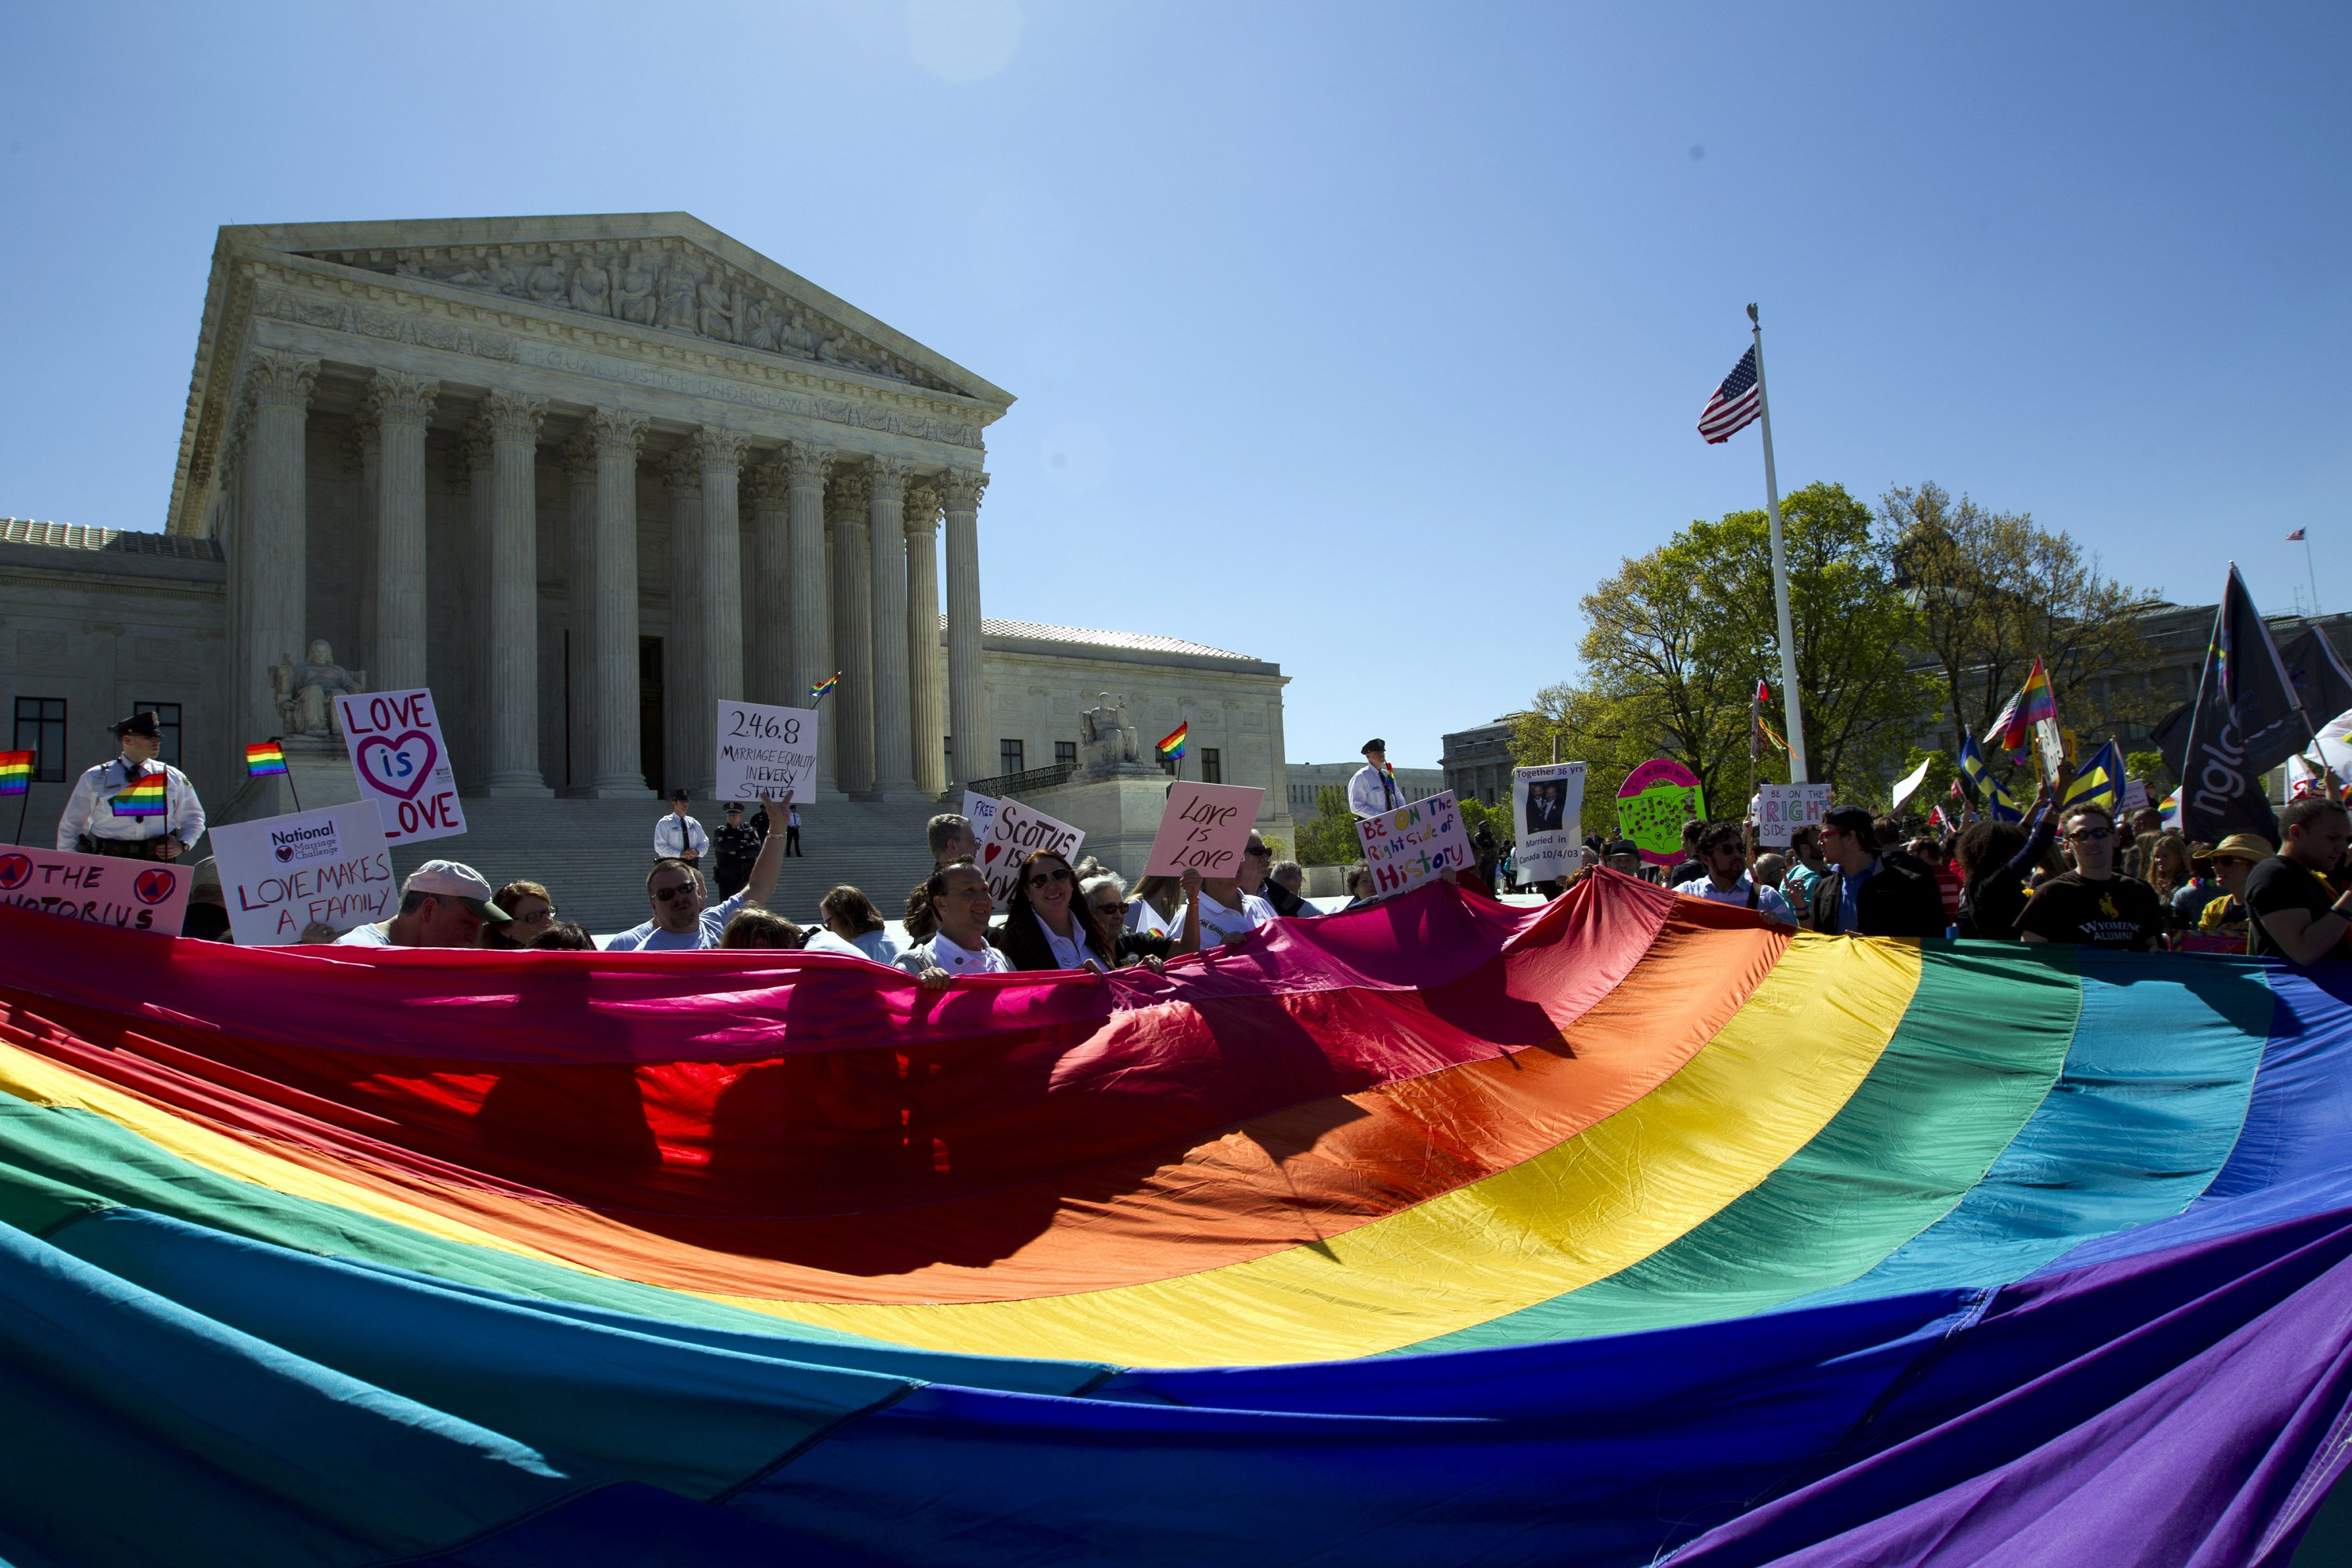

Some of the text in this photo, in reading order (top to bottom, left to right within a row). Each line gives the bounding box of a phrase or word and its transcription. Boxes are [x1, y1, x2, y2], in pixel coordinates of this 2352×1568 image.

[535, 348, 801, 411] EQUAL JUSTICE UNDER LAW
[343, 693, 432, 734] LOVE
[380, 748, 412, 777] is
[720, 745, 815, 781] MARRIAGE EQUALITY
[1516, 768, 1555, 779] Together
[1570, 766, 1584, 775] yrs
[758, 766, 798, 789] EVERY
[735, 782, 795, 798] STATE
[1771, 789, 1781, 798] BE
[1807, 790, 1824, 799] THE
[385, 791, 459, 837] OVE
[974, 800, 996, 816] FREE
[1766, 800, 1831, 822] RIGHT
[271, 820, 335, 846] National
[1363, 818, 1387, 840] BE
[1394, 805, 1421, 831] ON
[1763, 824, 1787, 837] SIDE
[294, 837, 336, 852] Marriage
[1367, 837, 1404, 862] Right
[1441, 814, 1454, 833] of
[1526, 836, 1553, 848] Married
[296, 846, 339, 861] Challenge
[1004, 848, 1025, 868] IS
[1519, 850, 1578, 864] Canada 10/4/03
[37, 864, 104, 889] THE
[238, 853, 390, 911] LOVE MAKES
[276, 887, 390, 935] A FAMILY
[2094, 931, 2132, 940] ALUMNI
